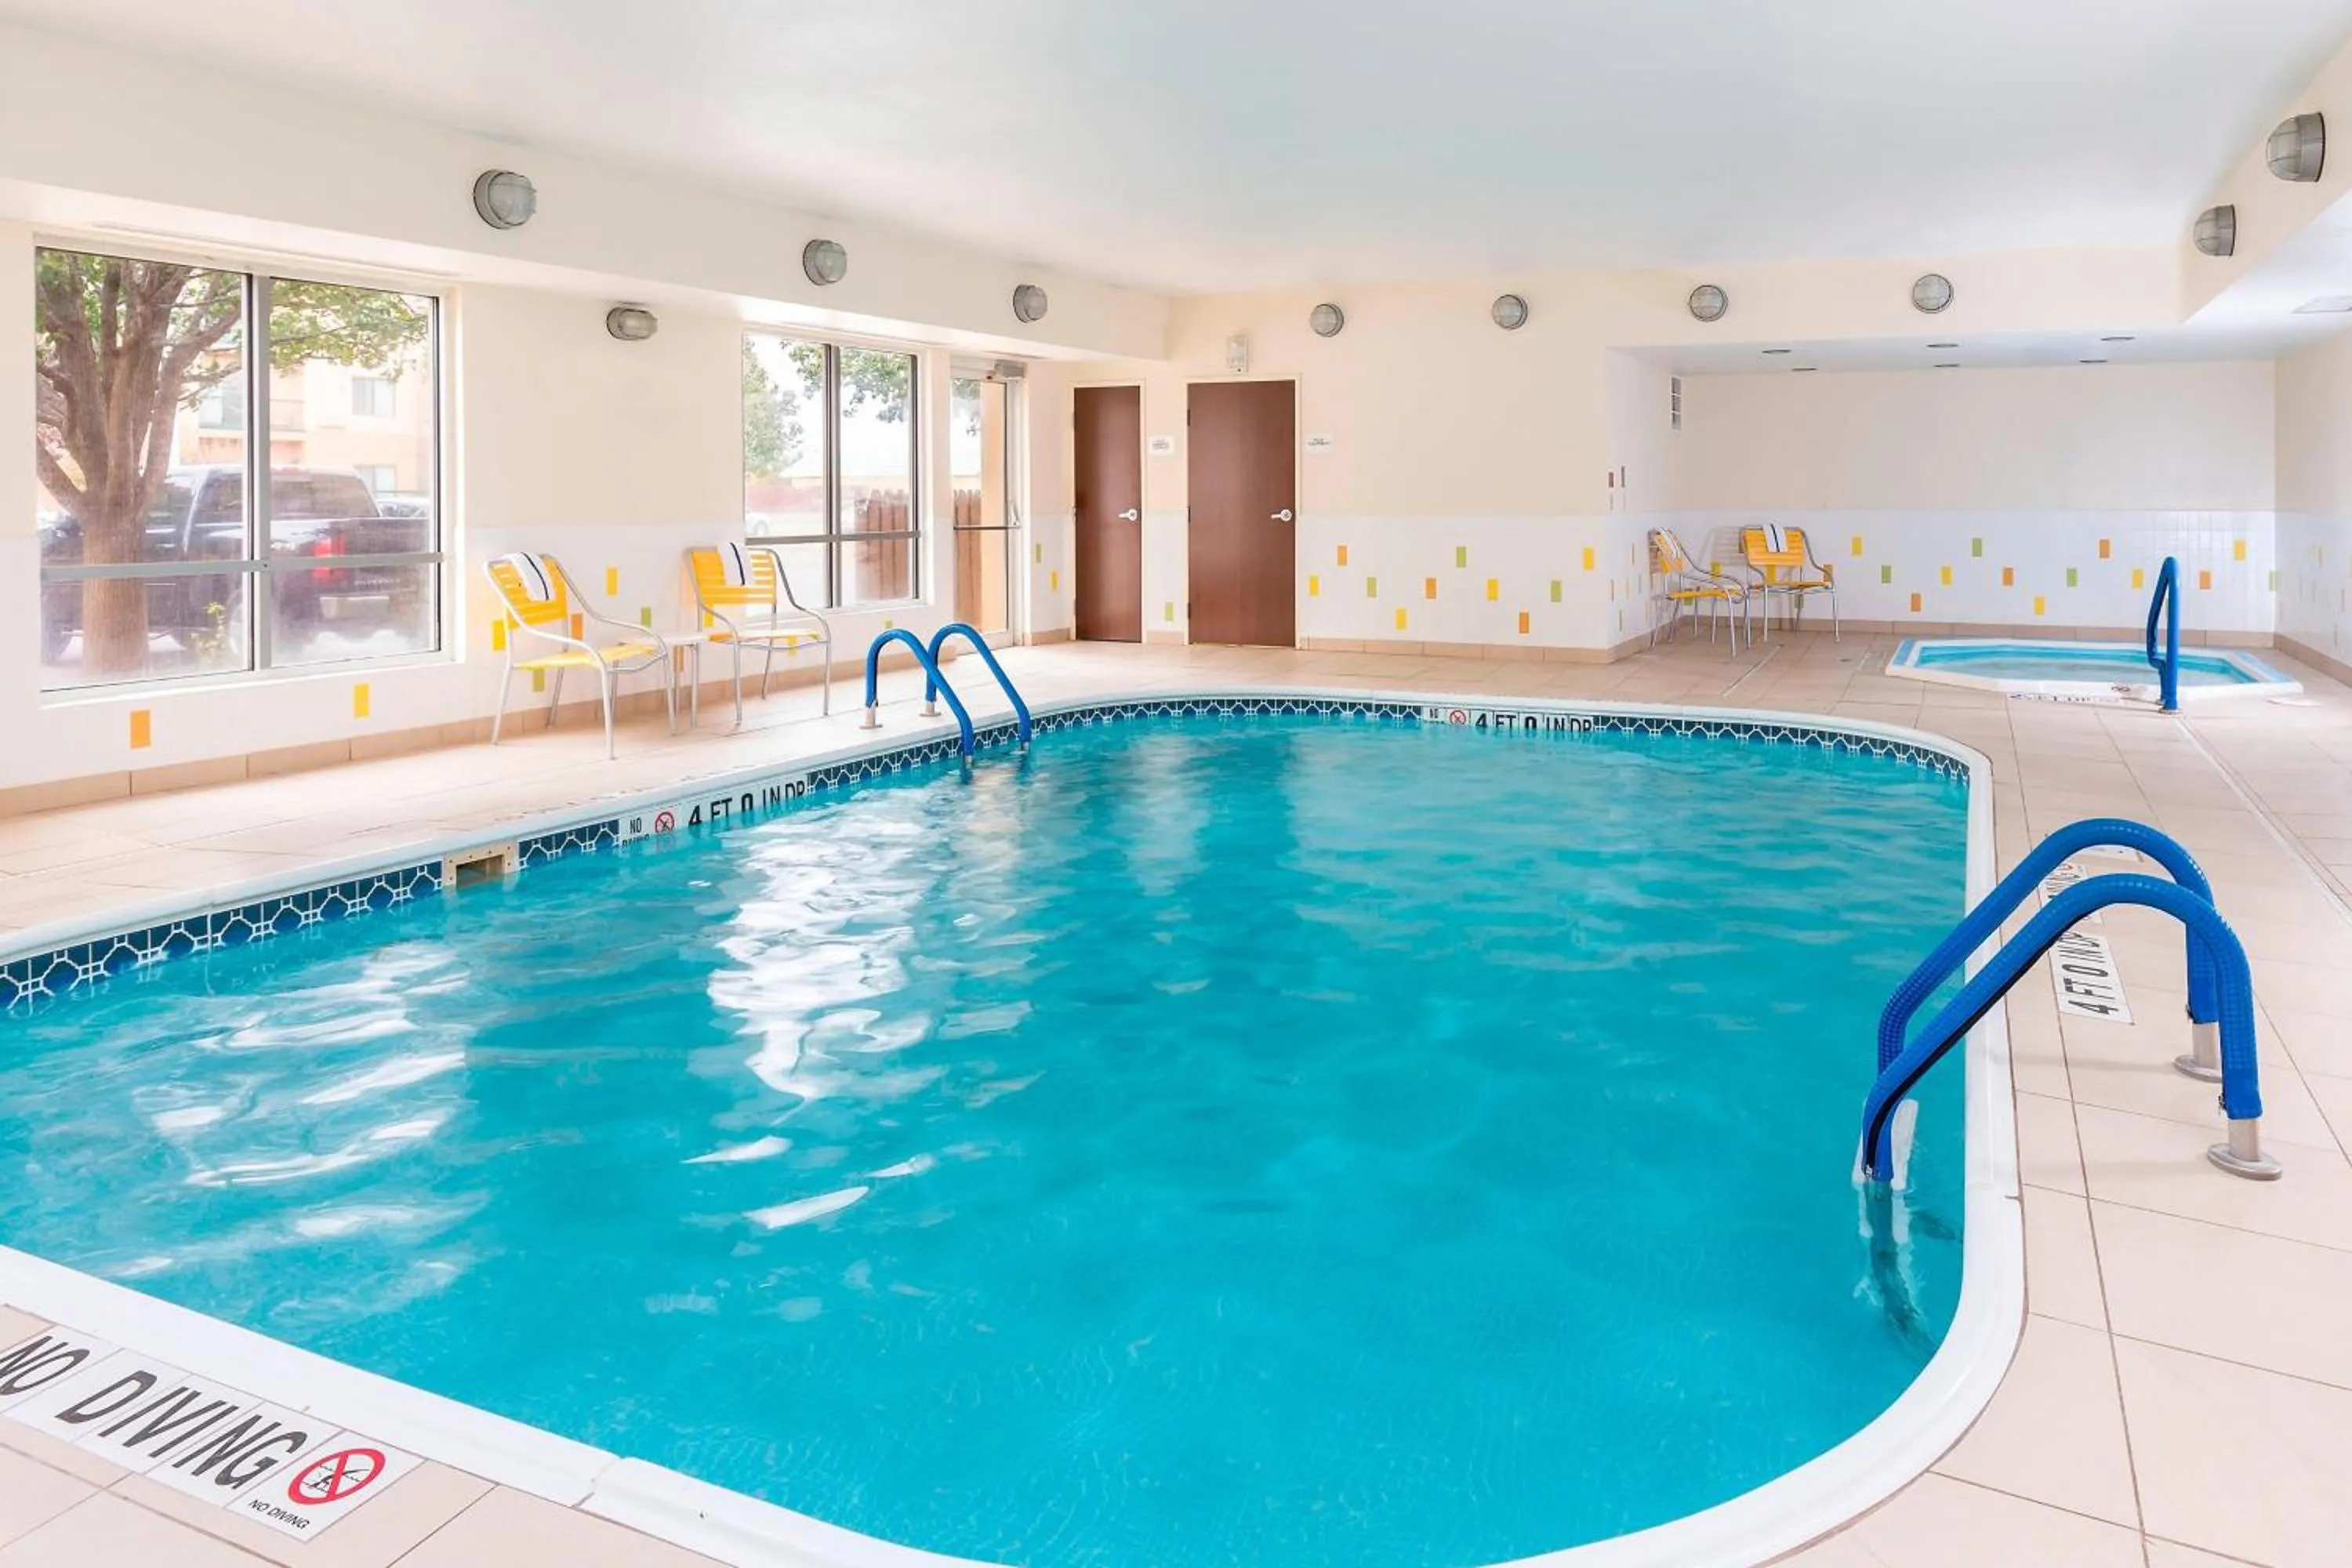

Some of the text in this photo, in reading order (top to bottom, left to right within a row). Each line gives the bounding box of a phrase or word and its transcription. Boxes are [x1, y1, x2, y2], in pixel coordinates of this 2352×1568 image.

[1475, 713, 1487, 728] 4
[1495, 714, 1516, 728] FT
[1546, 716, 1566, 731] IN
[688, 804, 702, 826] 4
[710, 797, 732, 822] FT
[763, 785, 782, 811] IN
[630, 817, 642, 834] NO
[2056, 944, 2107, 964] IN
[2063, 976, 2116, 1000] FT
[2067, 1000, 2120, 1015] 4
[0, 1335, 308, 1490] NO DIVING
[248, 1498, 310, 1530] NO DIVING
